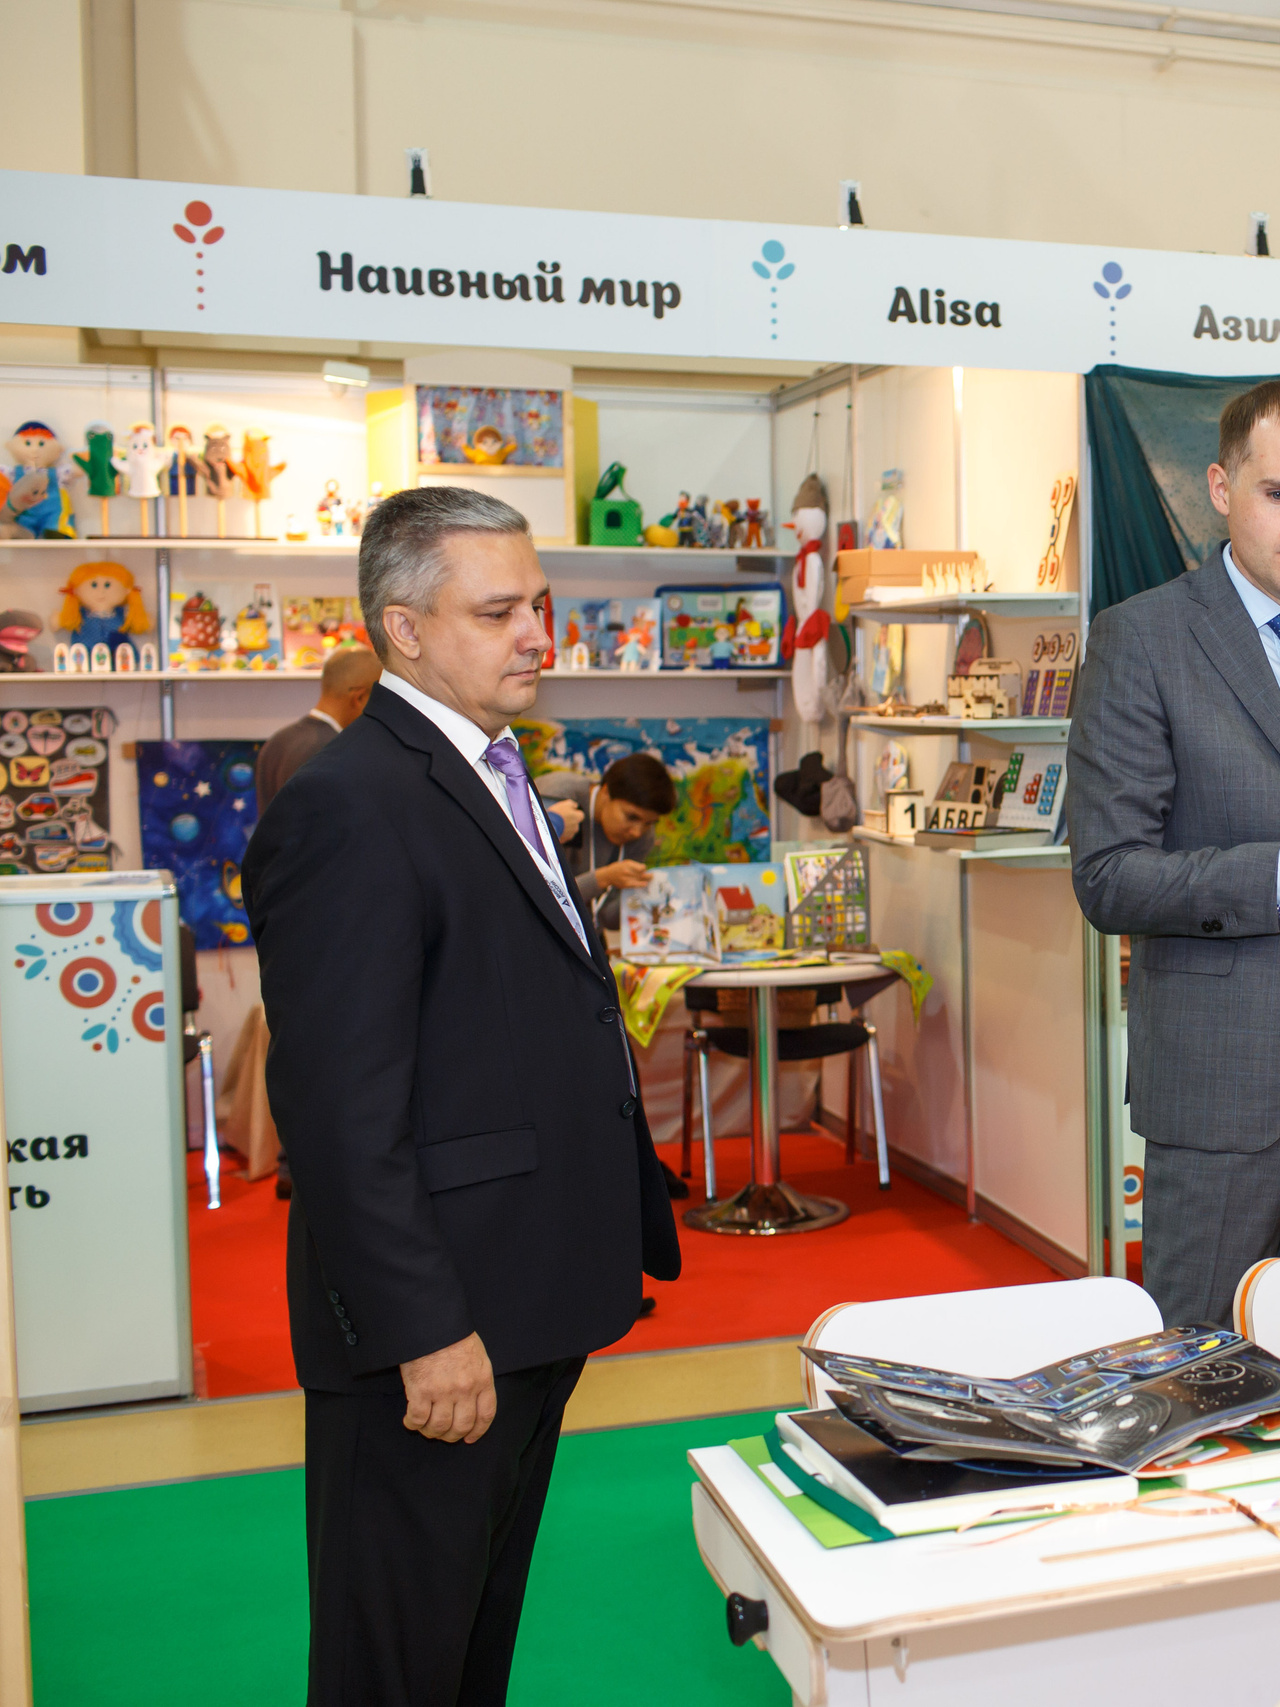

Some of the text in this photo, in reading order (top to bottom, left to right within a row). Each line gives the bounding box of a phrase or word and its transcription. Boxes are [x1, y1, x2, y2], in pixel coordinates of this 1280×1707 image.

[0, 243, 47, 276] м
[316, 250, 682, 319] Наивный мир
[887, 286, 1002, 328] Alisa
[904, 802, 916, 829] 1
[928, 806, 983, 829] АБВГ
